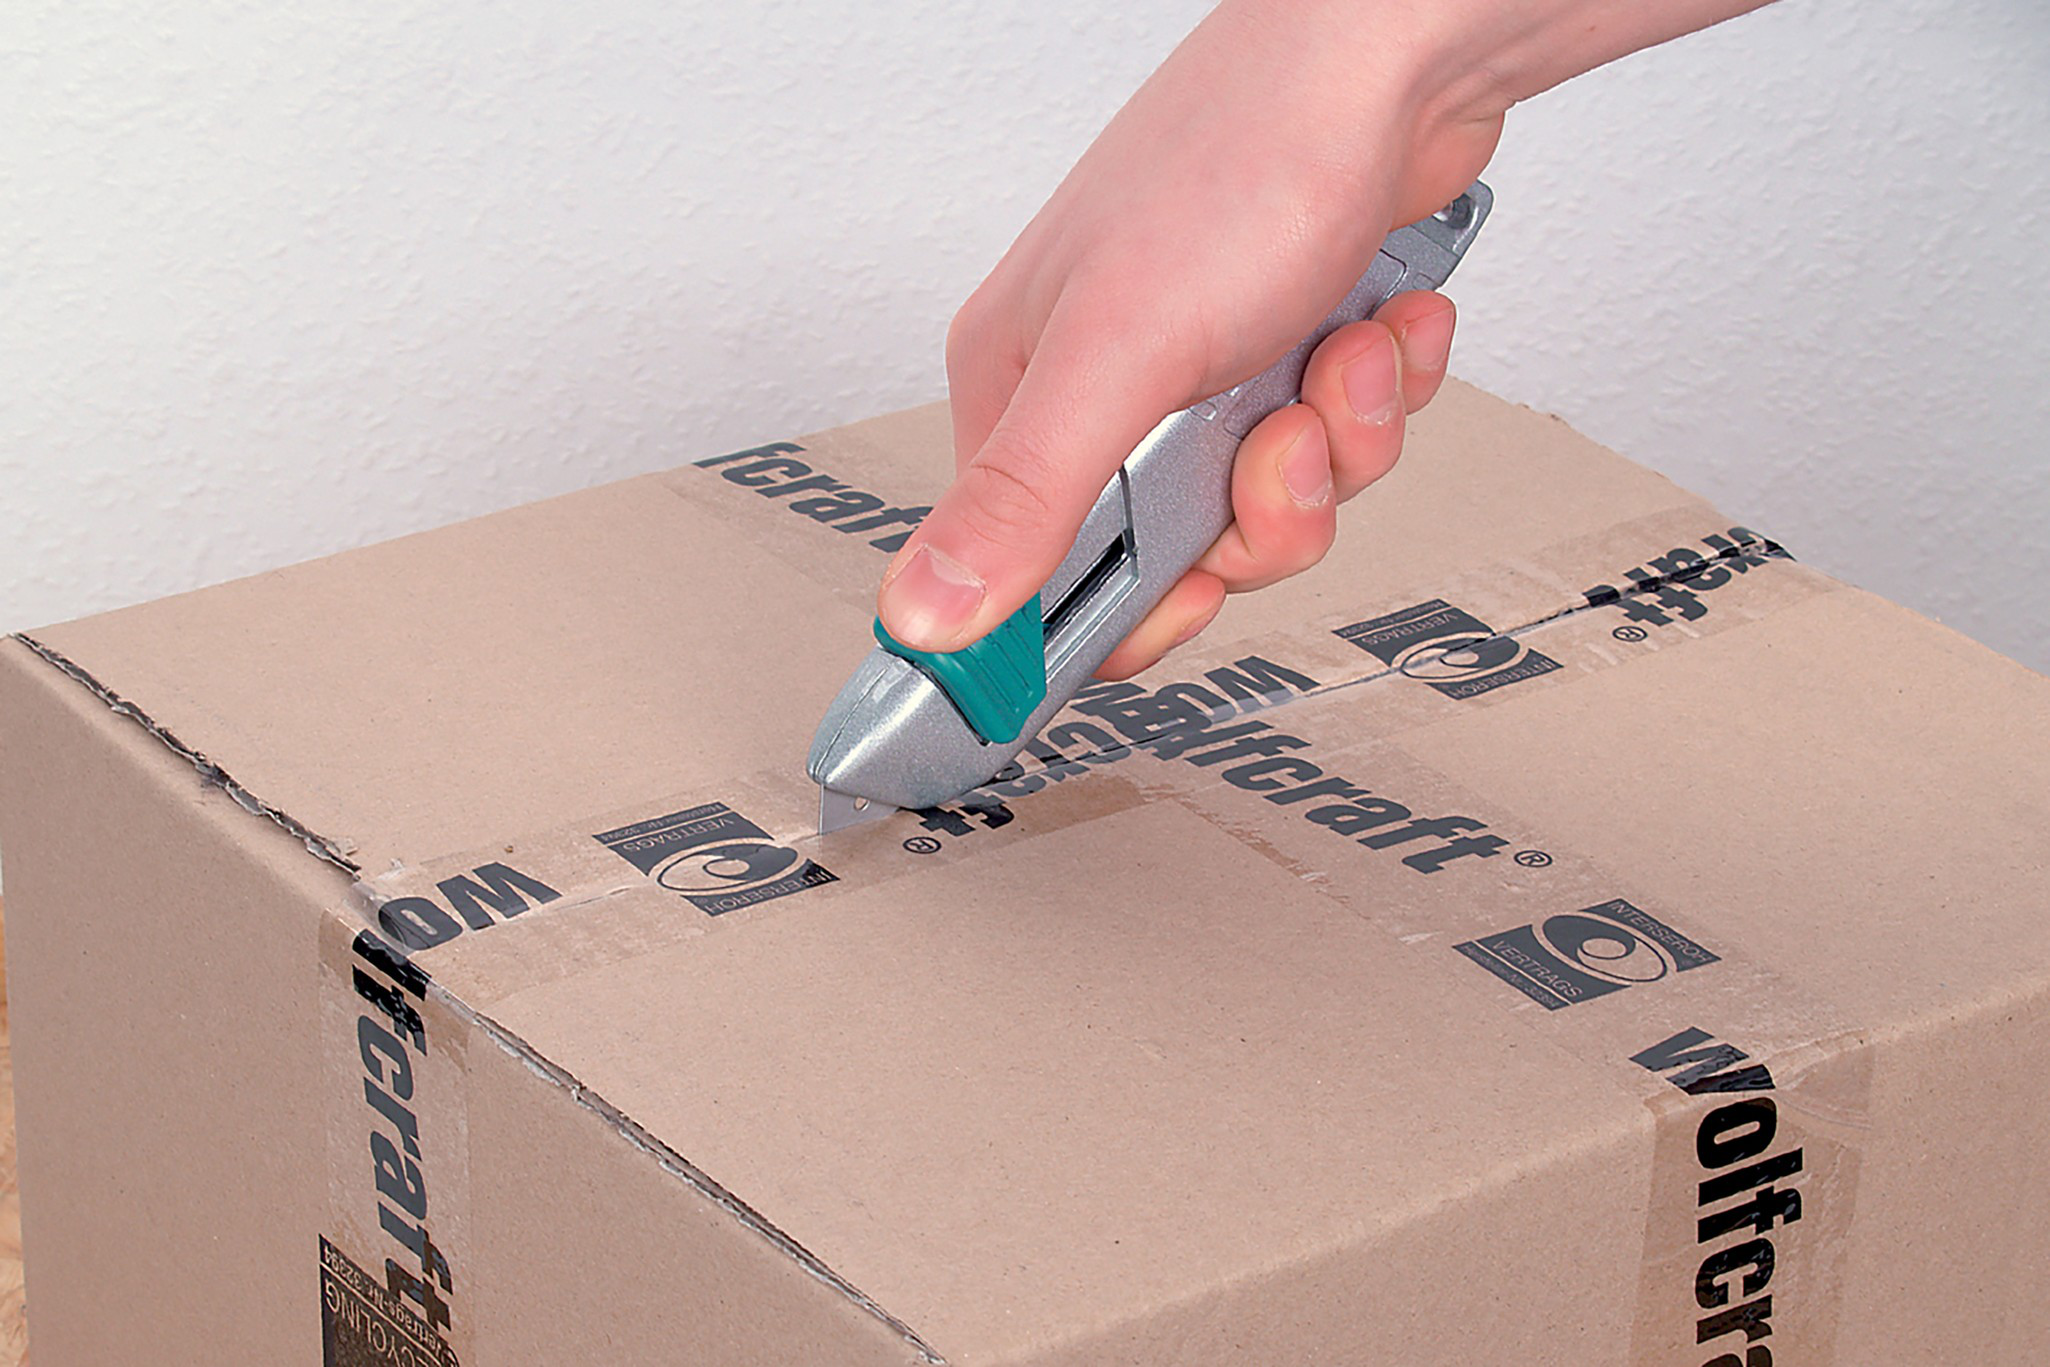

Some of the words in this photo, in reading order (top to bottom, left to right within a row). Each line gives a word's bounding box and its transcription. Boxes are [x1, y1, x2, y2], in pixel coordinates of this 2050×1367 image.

[622, 817, 735, 851] VERTRAGS
[704, 868, 832, 914] INTERSEROH
[1607, 901, 1714, 963] INTERSEROH
[1492, 940, 1583, 997] VERTRAGS
